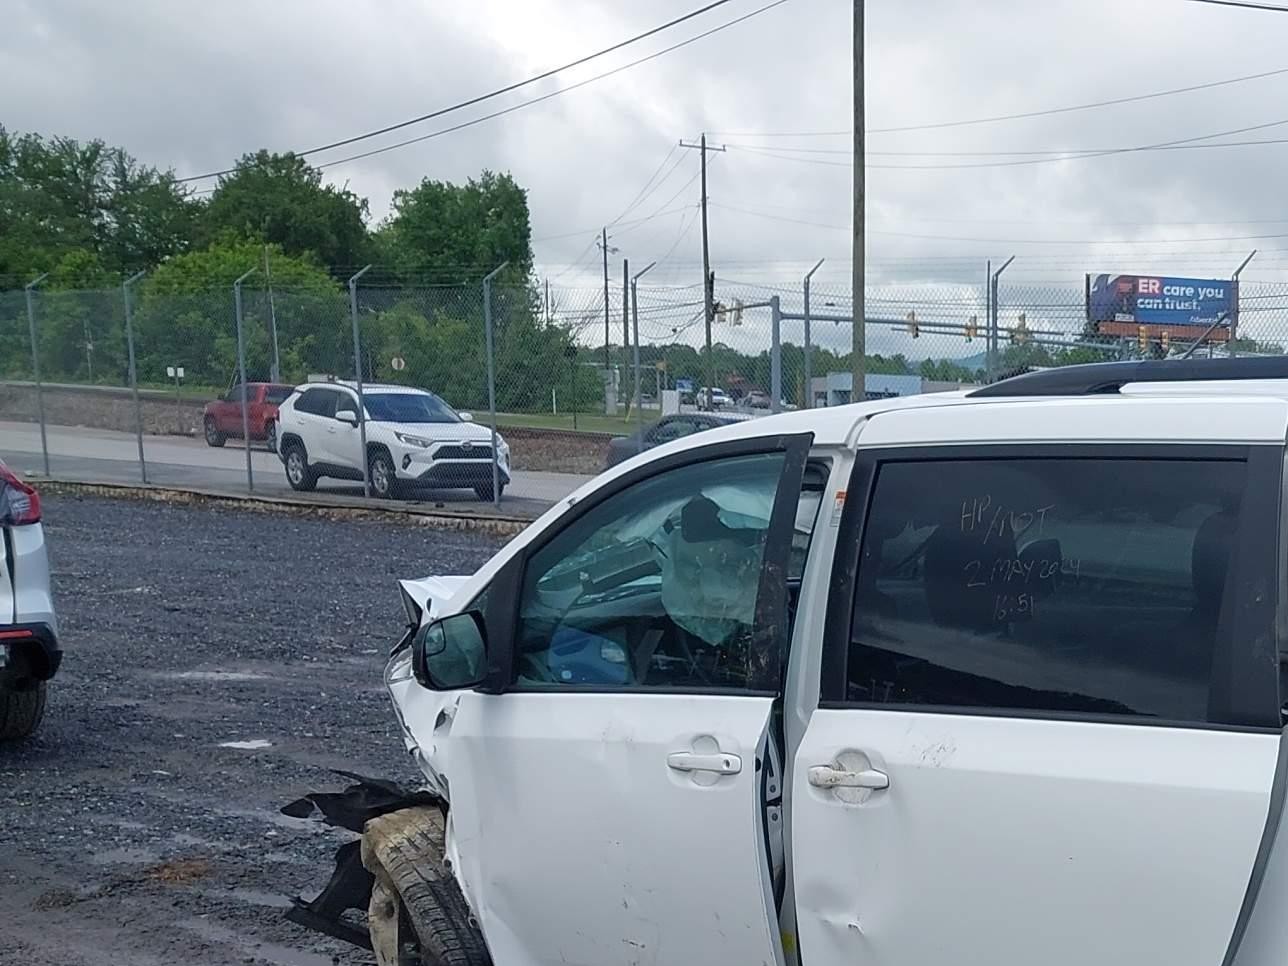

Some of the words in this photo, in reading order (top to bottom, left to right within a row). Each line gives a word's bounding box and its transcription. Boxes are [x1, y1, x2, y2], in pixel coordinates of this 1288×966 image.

[1138, 278, 1160, 294] ER
[1163, 285, 1195, 297] care
[1198, 286, 1224, 299] you
[1137, 297, 1163, 309] can
[963, 560, 986, 587] 2
